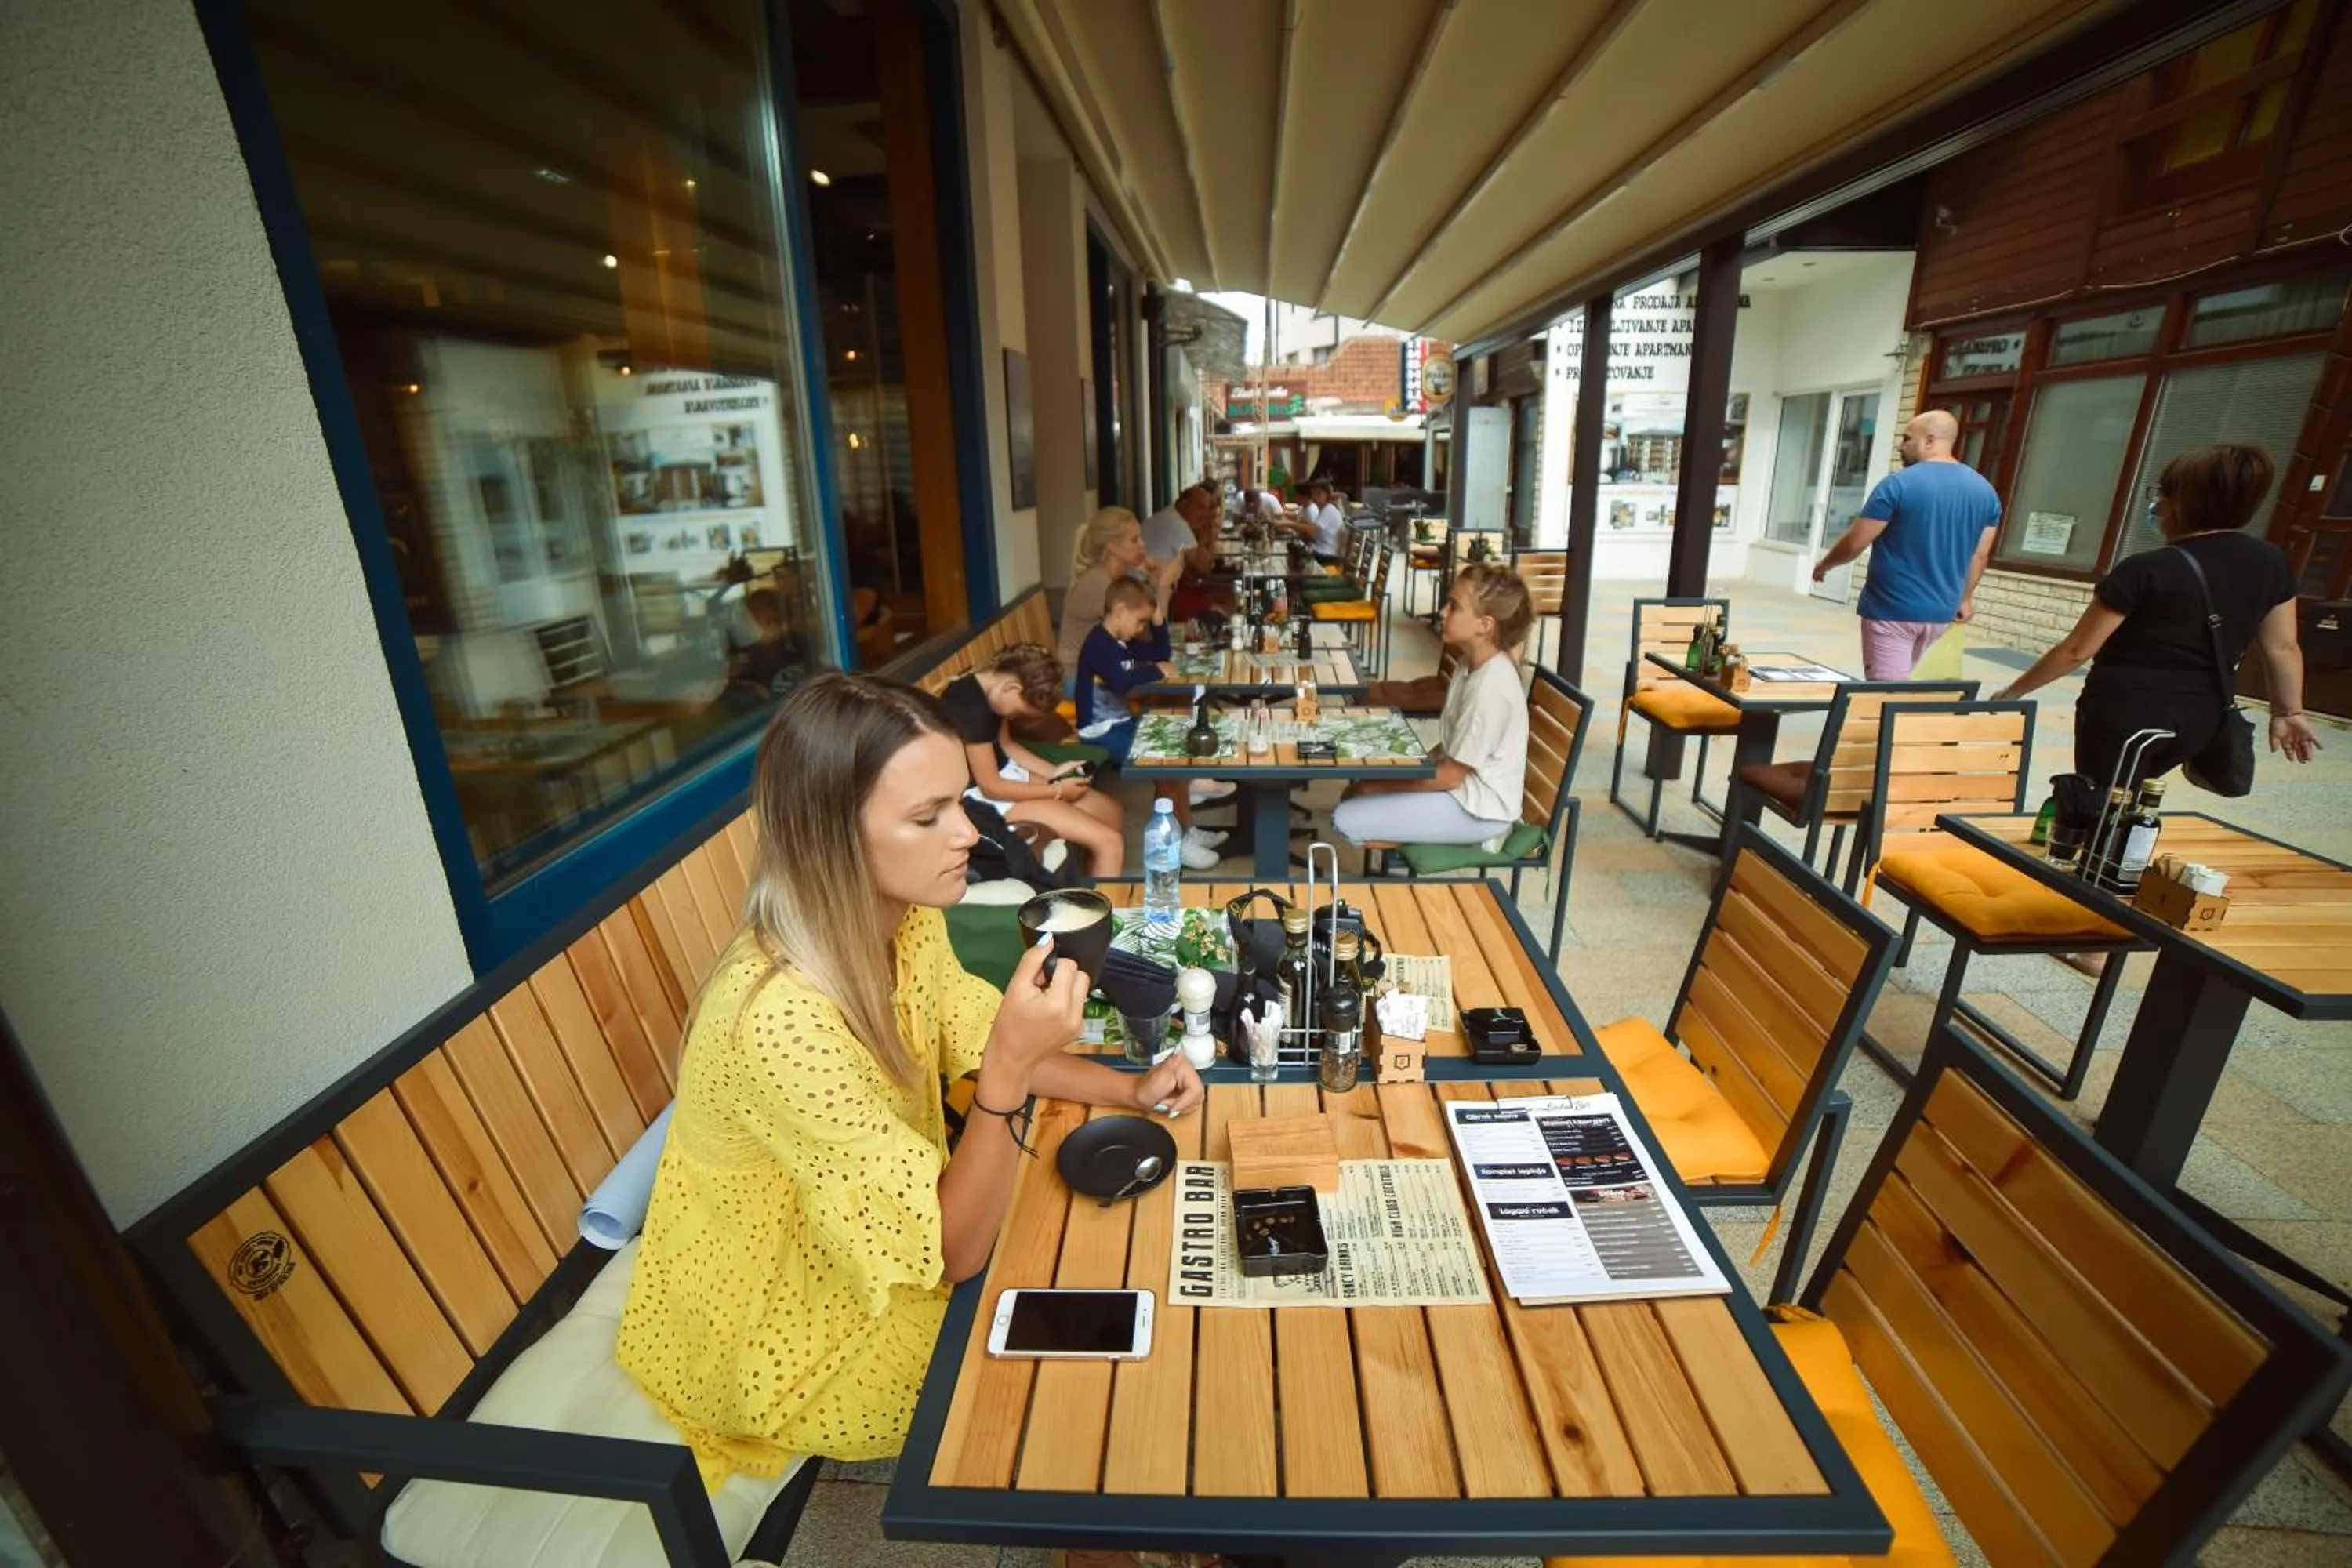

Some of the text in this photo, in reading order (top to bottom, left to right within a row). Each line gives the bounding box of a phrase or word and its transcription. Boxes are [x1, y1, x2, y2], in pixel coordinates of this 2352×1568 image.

[1633, 295, 1682, 310] PRODAJA
[1635, 343, 1692, 357] APARTMAN
[1385, 1199, 1401, 1219] CLASS
[1180, 1166, 1214, 1297] GASTRO BAR
[1337, 1243, 1356, 1298] FANCY DRINKS
